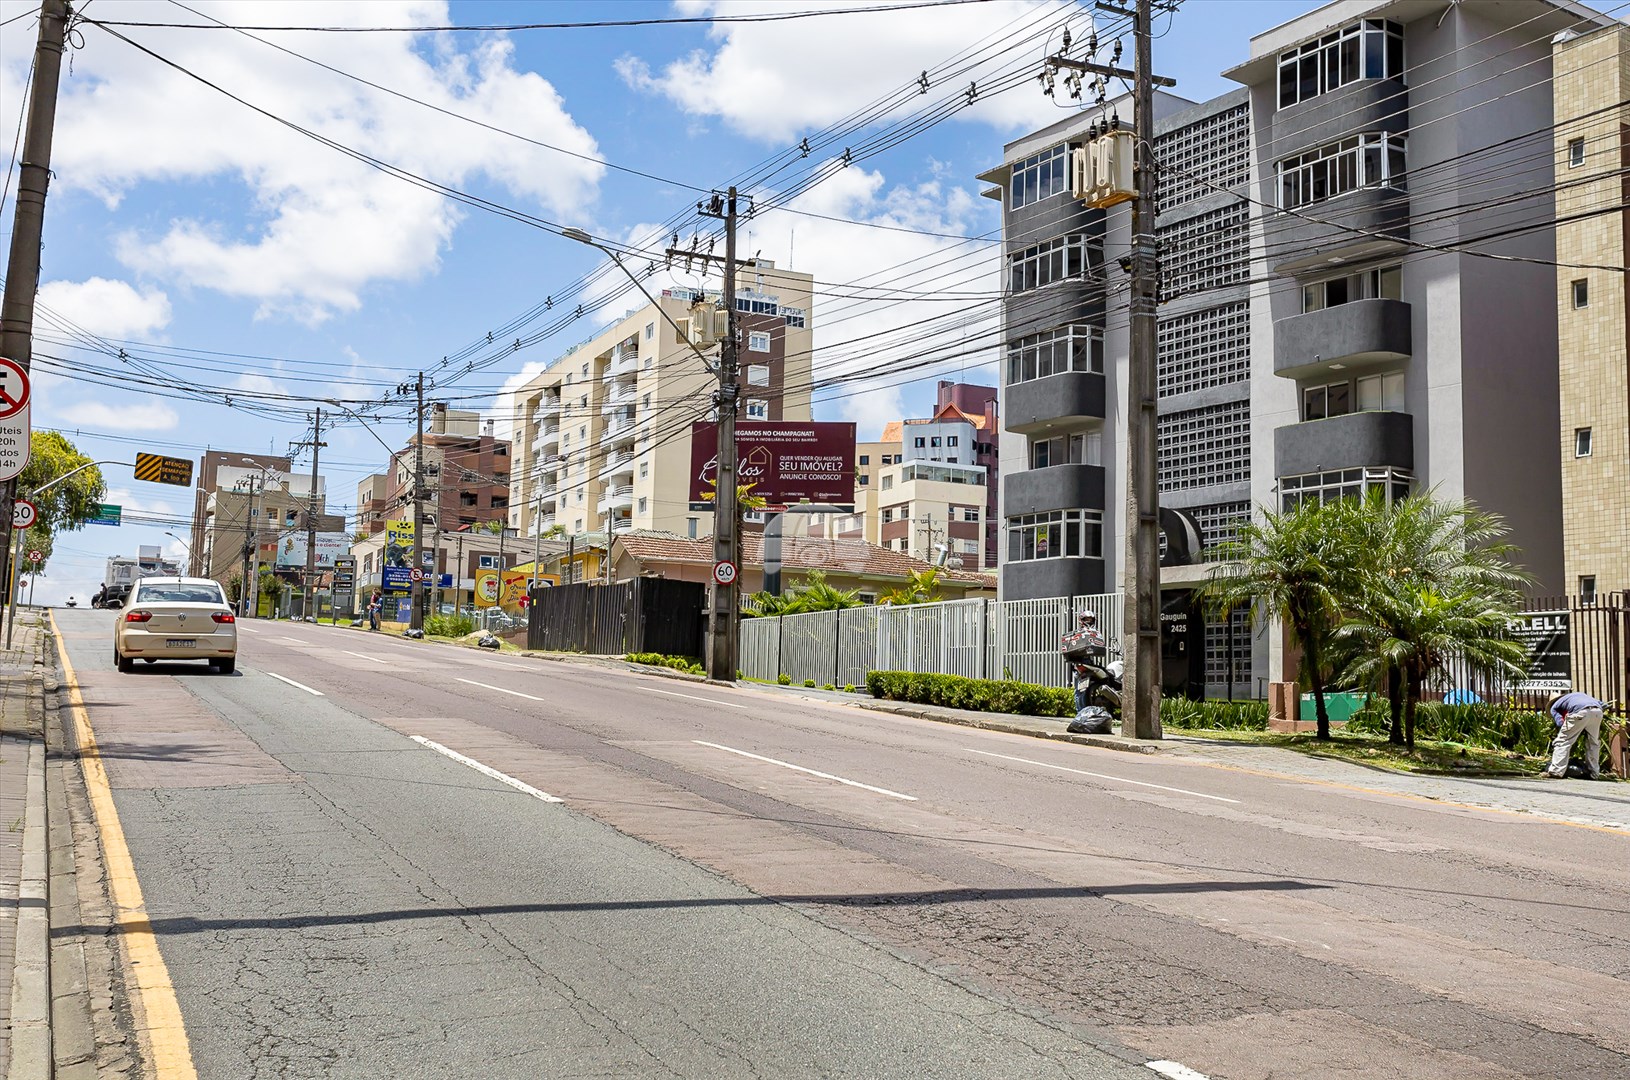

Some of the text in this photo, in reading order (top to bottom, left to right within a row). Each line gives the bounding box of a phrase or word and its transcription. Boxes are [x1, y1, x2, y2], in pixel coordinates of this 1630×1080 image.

[779, 461, 843, 471] SEU IMÓVEL?
[717, 565, 733, 576] 60
[1160, 612, 1187, 622] Gauguin
[1170, 624, 1187, 633] 2425
